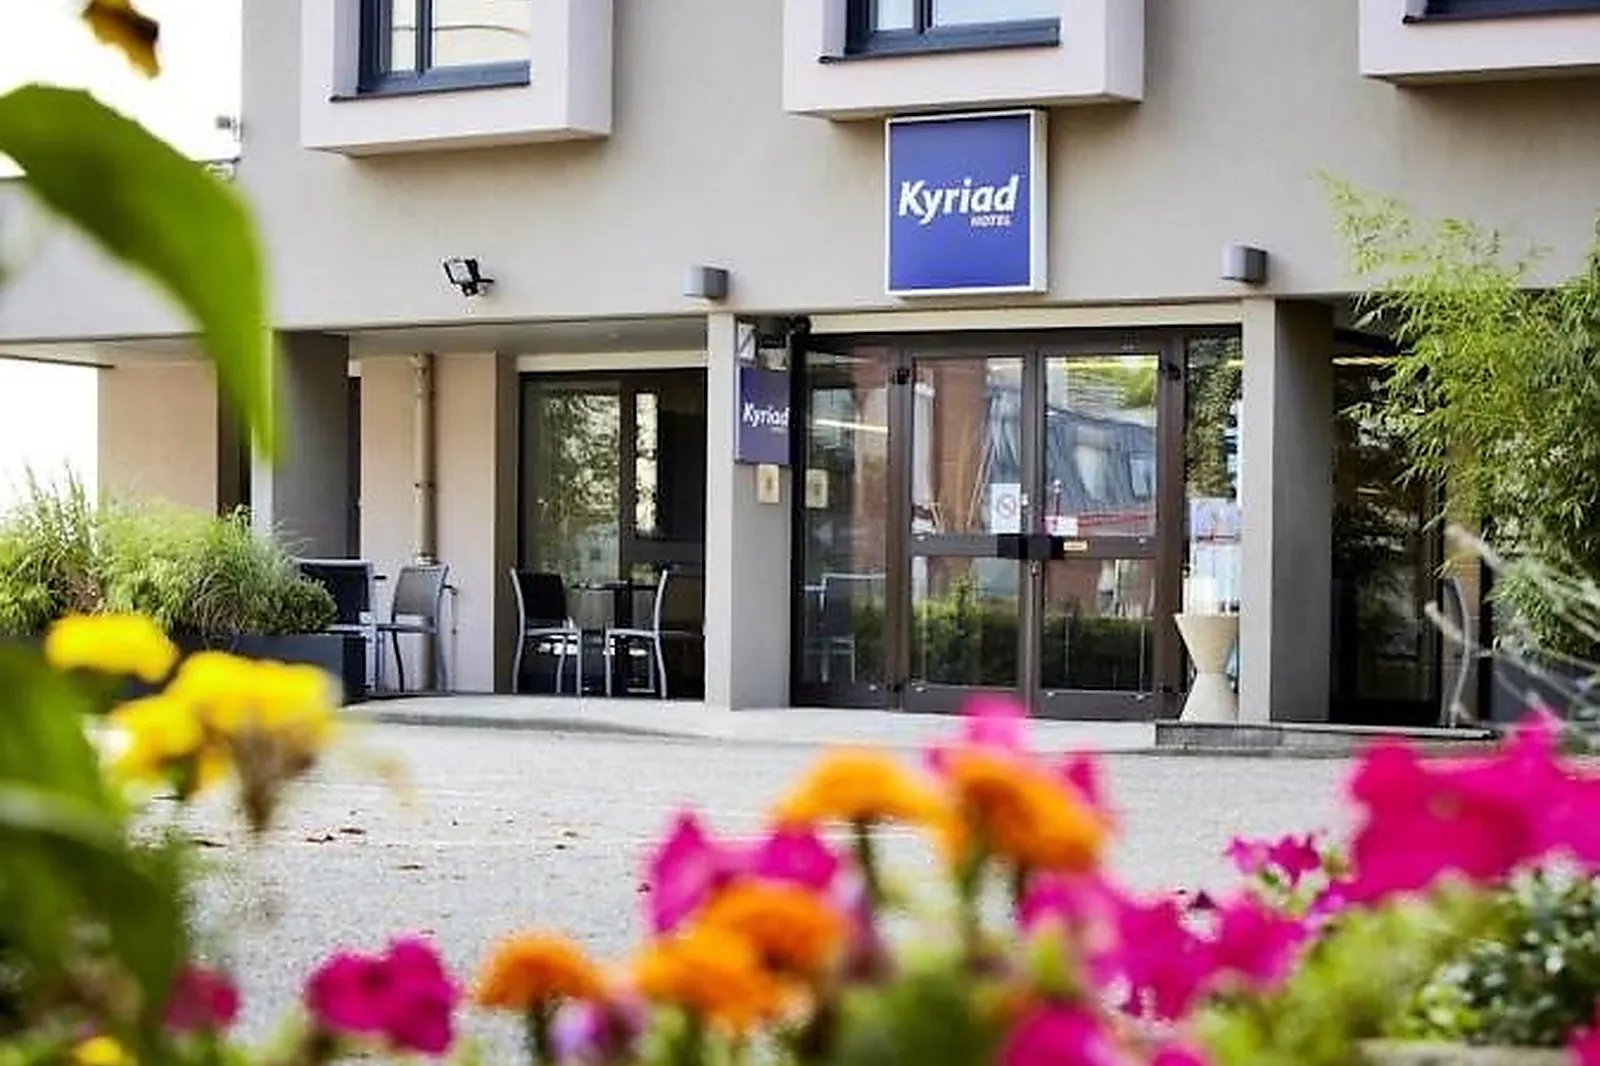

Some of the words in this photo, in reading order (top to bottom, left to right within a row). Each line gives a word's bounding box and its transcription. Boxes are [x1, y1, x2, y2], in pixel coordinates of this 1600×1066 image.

[898, 174, 1019, 224] Kyriad
[970, 214, 1012, 227] HOTEL
[742, 402, 789, 427] Kyriad
